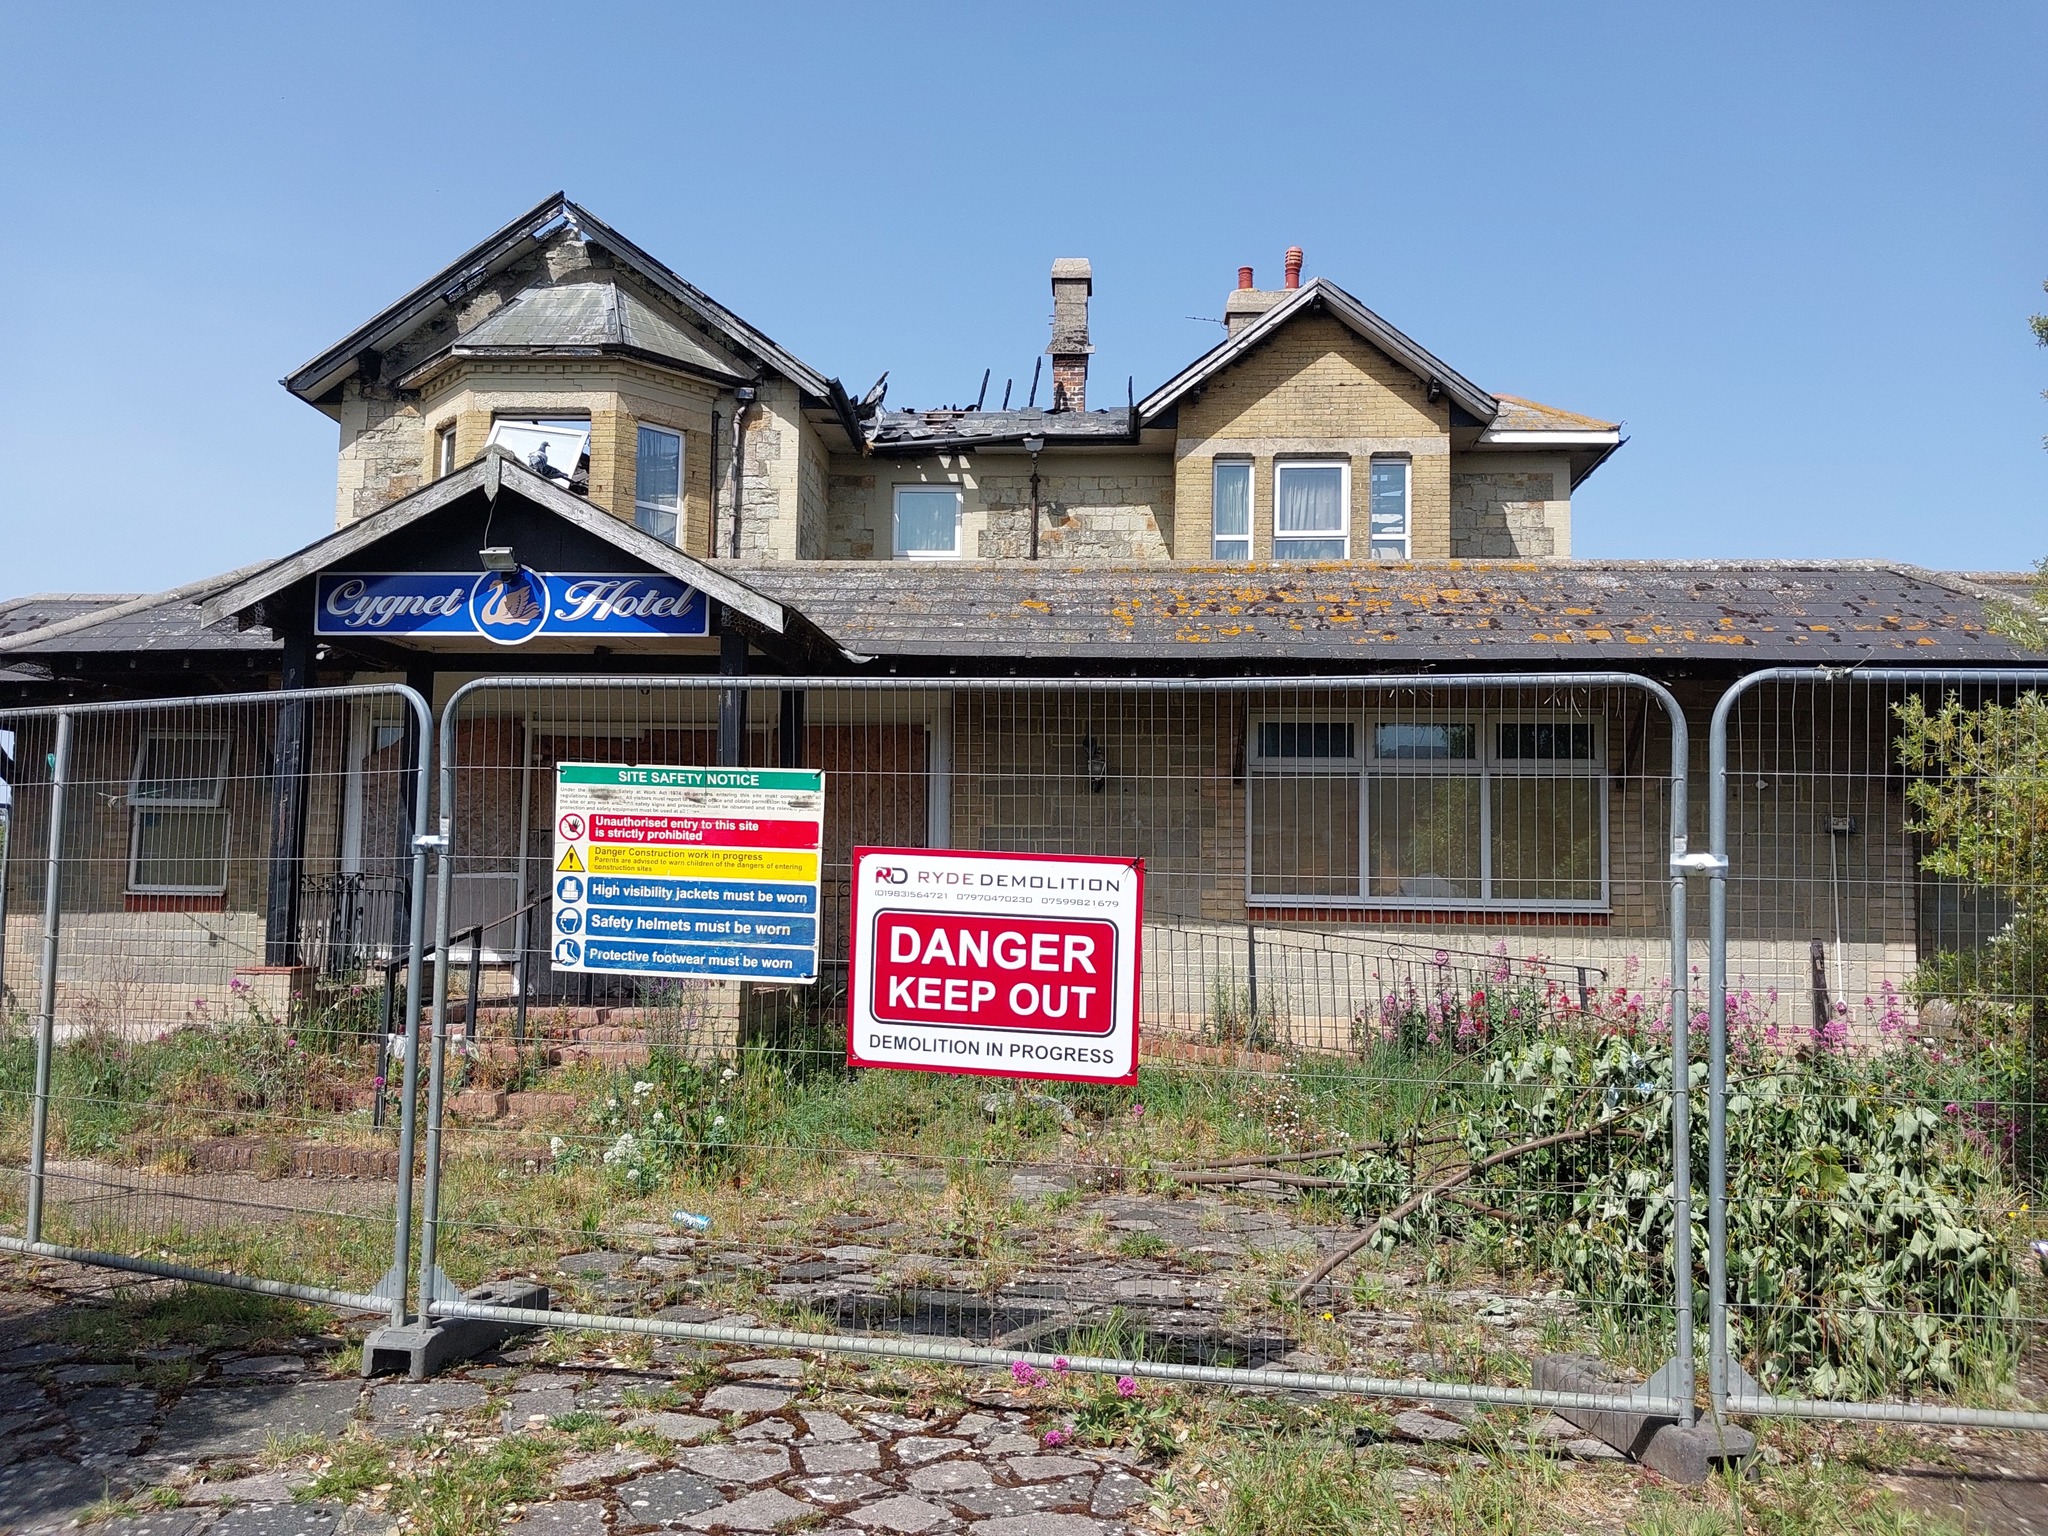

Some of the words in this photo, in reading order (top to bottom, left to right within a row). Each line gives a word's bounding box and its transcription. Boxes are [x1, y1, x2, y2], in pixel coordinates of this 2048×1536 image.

[326, 579, 465, 628] Cygnet
[555, 580, 698, 621] Hotel
[619, 771, 647, 784] SITE
[651, 772, 702, 785] SAFETY
[707, 774, 759, 786] NOTICE
[596, 816, 668, 828] Unauthorised
[670, 819, 698, 831] entry
[701, 820, 713, 829] to
[715, 820, 736, 830] this
[739, 821, 759, 831] site
[595, 829, 605, 837] is
[608, 829, 644, 841] strictly
[647, 830, 702, 842] prohibited
[595, 847, 626, 857] Danger
[628, 848, 685, 858] Construction
[687, 851, 709, 859] work
[712, 851, 720, 859] in
[723, 852, 763, 861] progress
[687, 859, 714, 867] children
[737, 861, 765, 870] dangers
[775, 863, 803, 871] entering
[918, 871, 974, 885] RYDE
[980, 875, 1120, 891] DEMOLITION
[592, 884, 620, 896] High
[623, 885, 673, 900] visibility
[675, 886, 719, 901] jackets
[723, 890, 756, 901] must
[758, 891, 773, 902] be
[777, 893, 807, 904] worn
[875, 890, 948, 899] (01983)564721
[957, 893, 1033, 903] 07970470230
[1042, 897, 1119, 908] 07599821679
[591, 914, 633, 929] Safety
[637, 917, 691, 931] helmets
[695, 921, 730, 932] must
[734, 922, 751, 933] be
[755, 924, 791, 935] worn
[589, 948, 649, 962] Protective
[652, 951, 705, 964] footwear
[708, 955, 740, 966] must
[743, 956, 758, 967] be
[761, 958, 792, 969] worn
[890, 926, 1097, 974] DANGER
[889, 976, 996, 1013] KEEP
[1009, 982, 1096, 1019] OUT
[870, 1034, 980, 1055] DEMOLITION
[987, 1043, 1003, 1056] IN
[1010, 1044, 1114, 1064] PROGRESS
